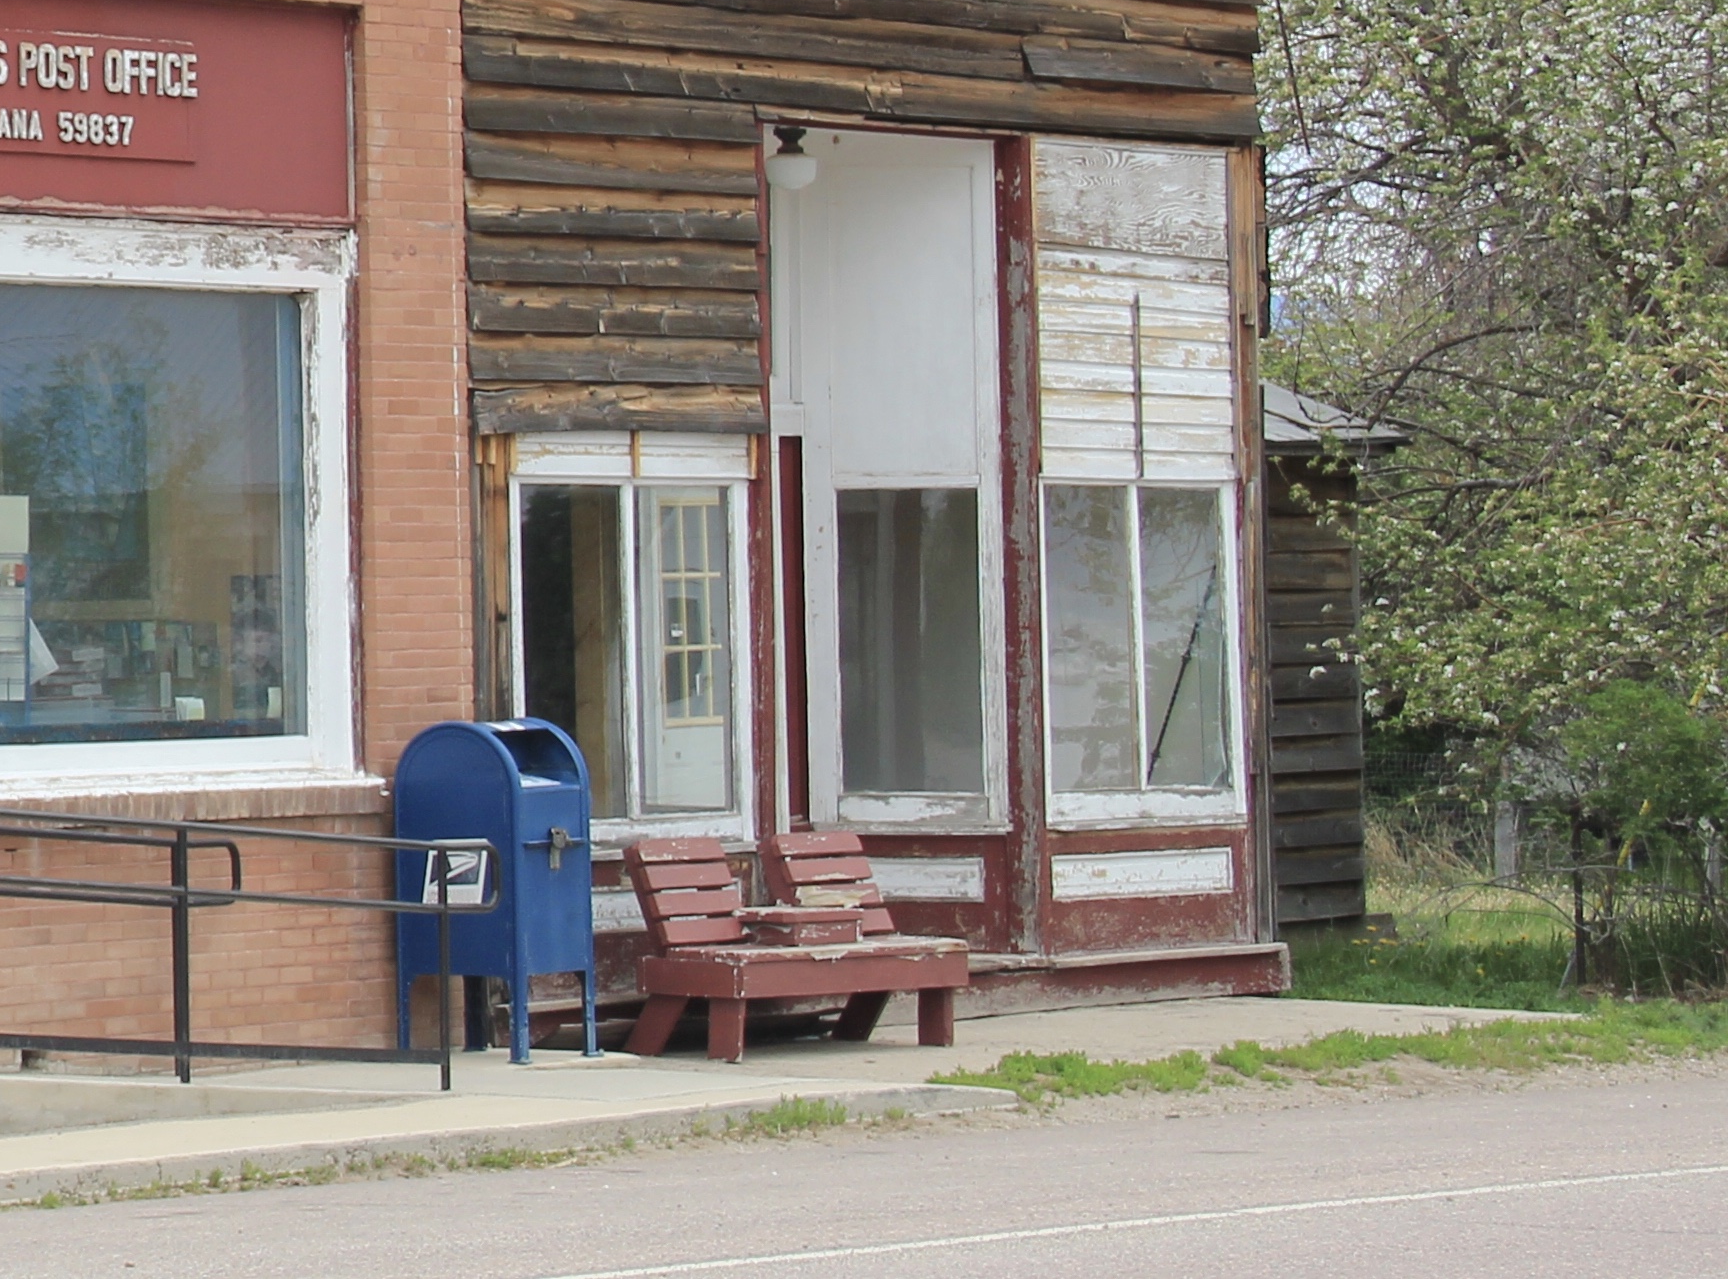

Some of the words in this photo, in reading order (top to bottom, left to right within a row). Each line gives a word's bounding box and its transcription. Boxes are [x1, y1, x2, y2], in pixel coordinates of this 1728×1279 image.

[19, 41, 94, 92] POST
[103, 48, 199, 98] OFFICE
[57, 111, 134, 146] 59837
